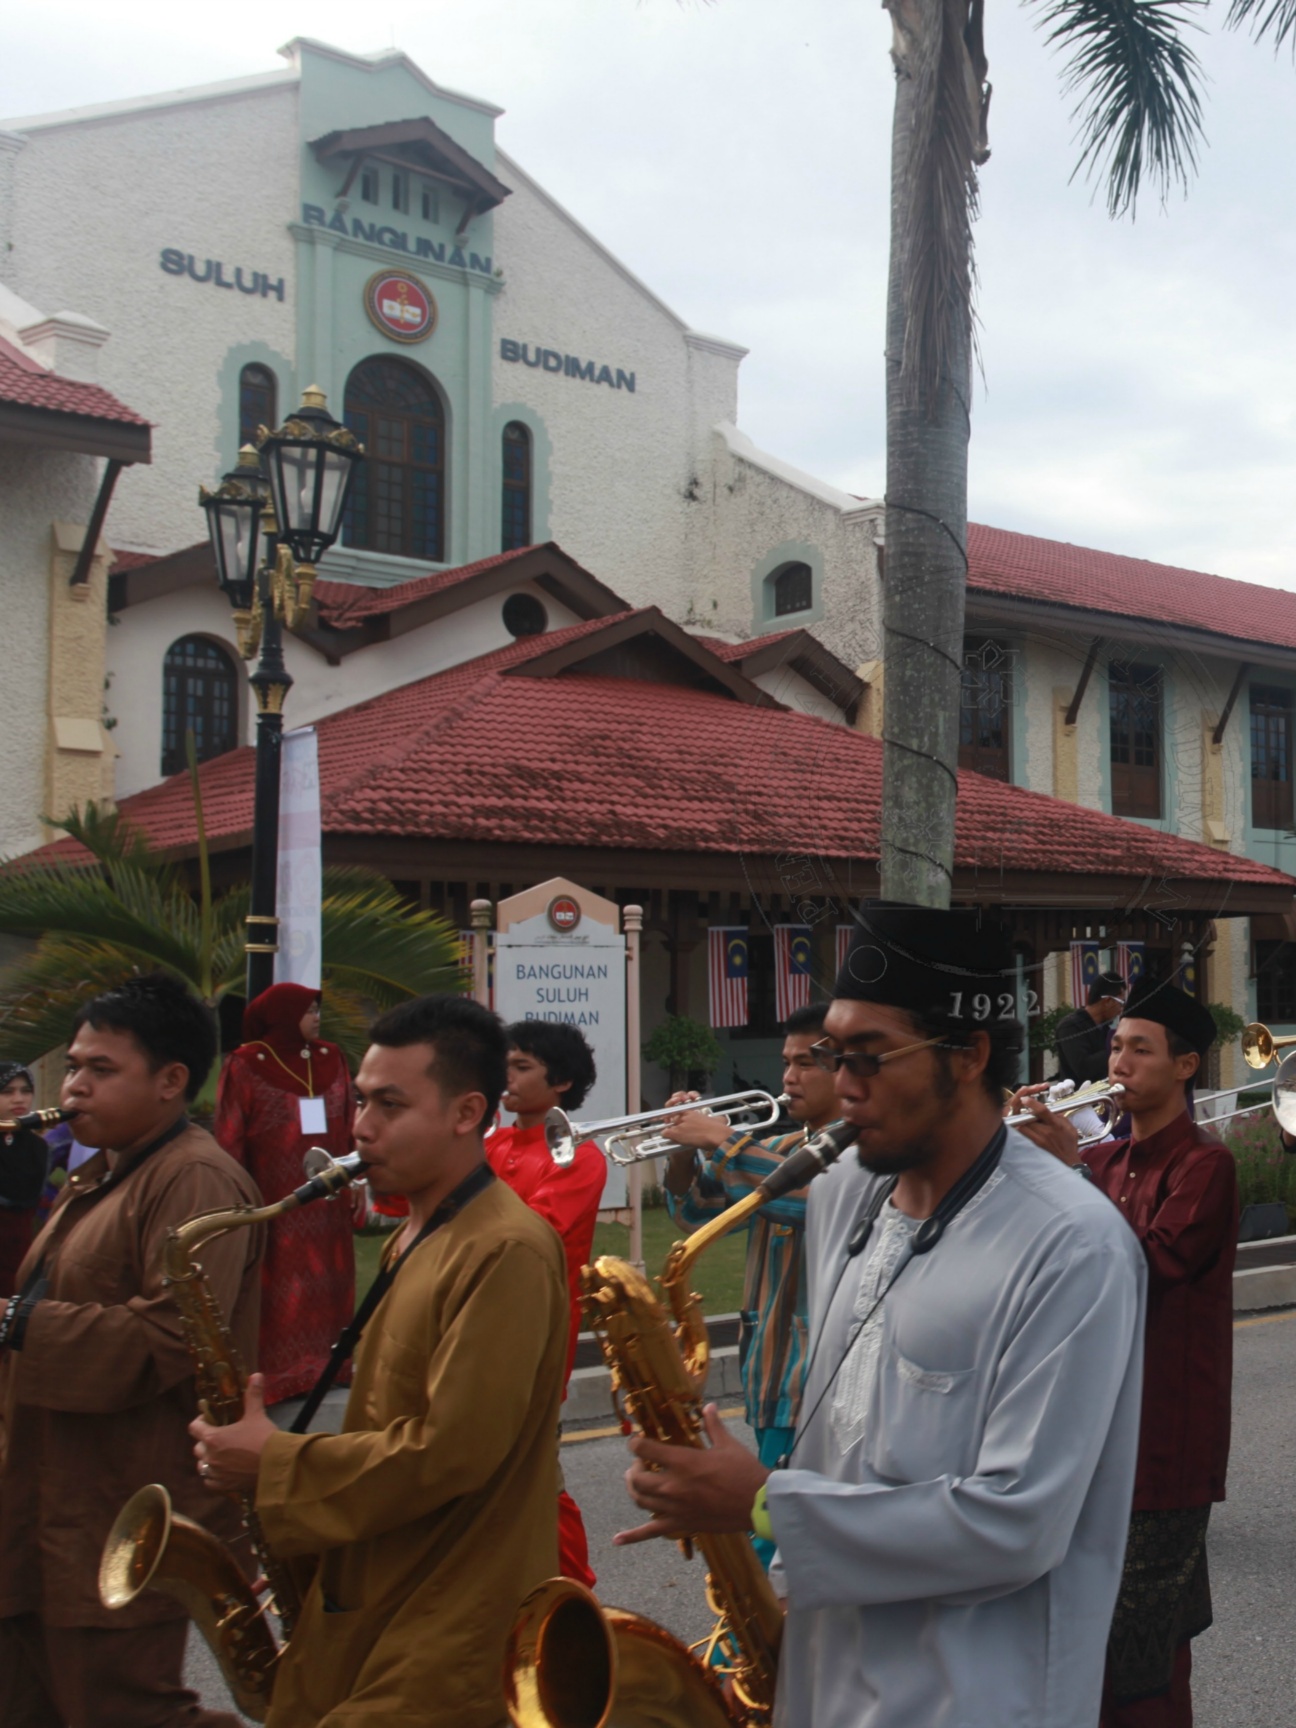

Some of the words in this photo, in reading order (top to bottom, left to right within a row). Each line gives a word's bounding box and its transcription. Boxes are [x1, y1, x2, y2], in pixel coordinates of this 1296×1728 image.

[302, 203, 493, 275] BANGUNAN
[159, 247, 286, 302] SULUH
[500, 338, 637, 393] BUDIMAN
[516, 964, 608, 980] BANGUNAN
[536, 987, 589, 1003] SULUH
[525, 1010, 600, 1026] BUDIMAN
